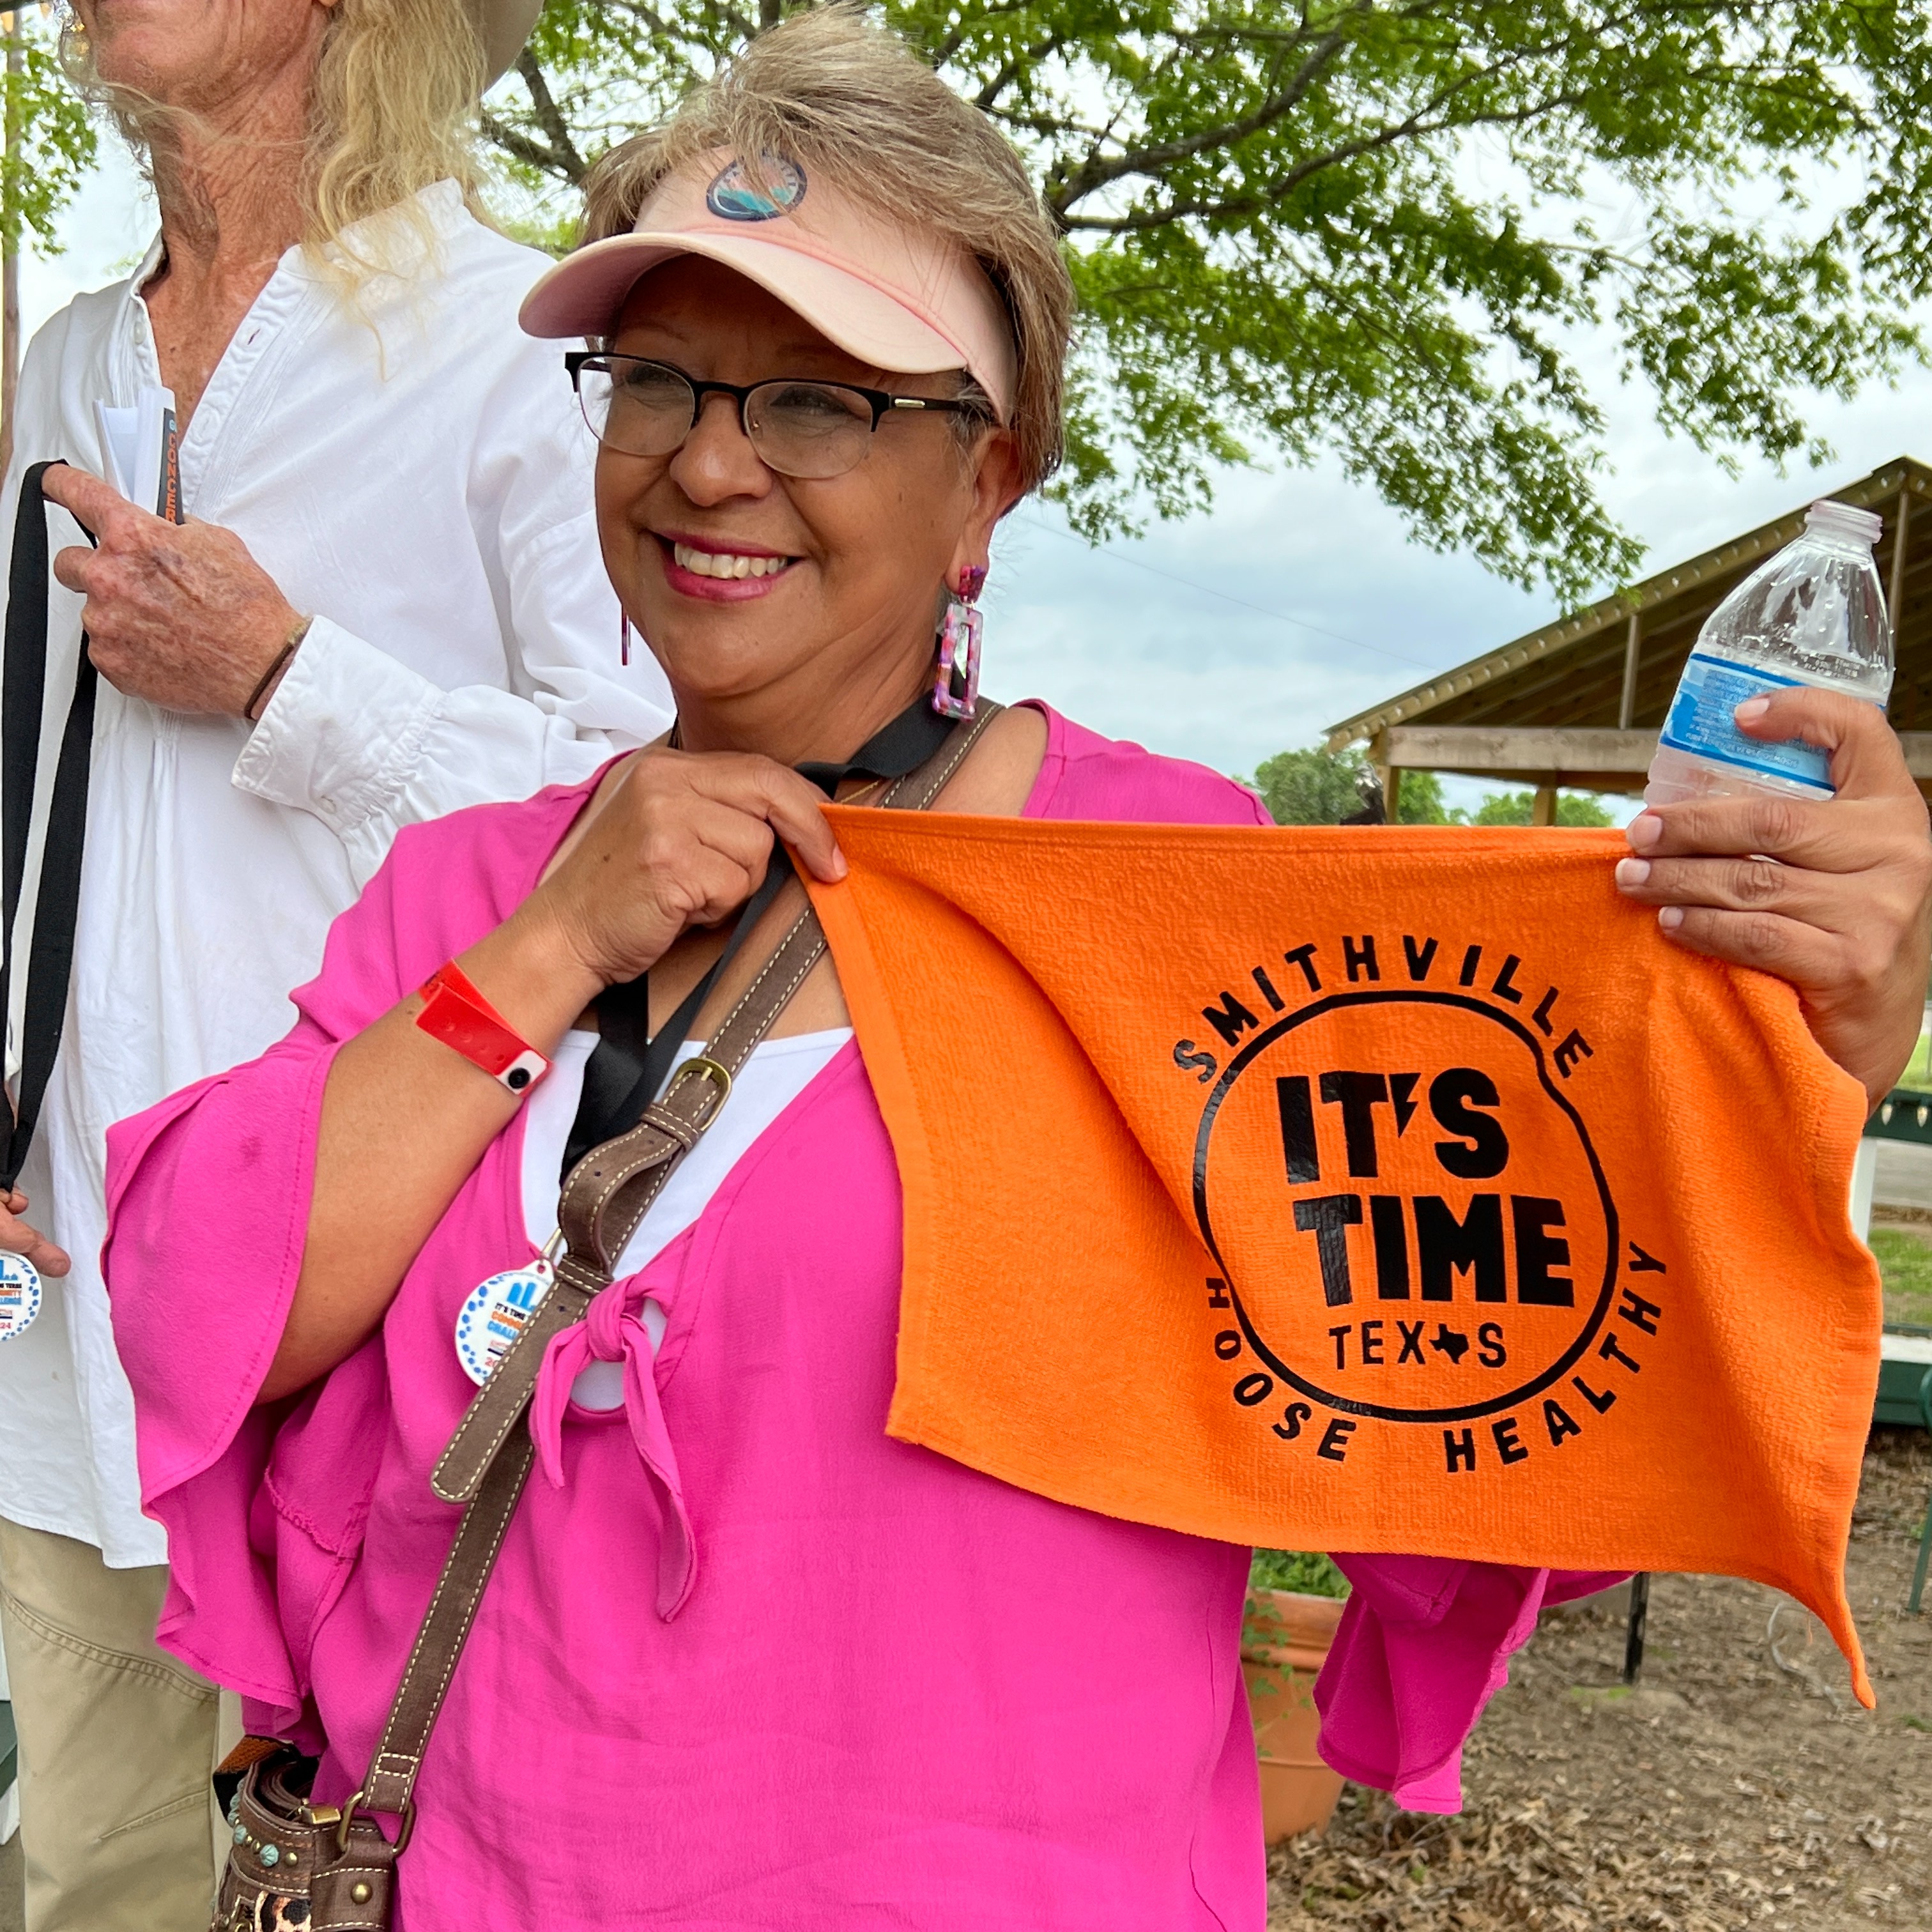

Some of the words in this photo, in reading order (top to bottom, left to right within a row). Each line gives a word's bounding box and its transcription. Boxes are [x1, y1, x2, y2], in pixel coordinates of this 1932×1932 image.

[1172, 934, 1594, 1083] SMITHVILLE
[1275, 1067, 1510, 1184] IT'S
[1292, 1193, 1575, 1308] TIME
[1204, 1249, 1357, 1462] HOOSE
[1443, 1240, 1667, 1473] HEALTHY
